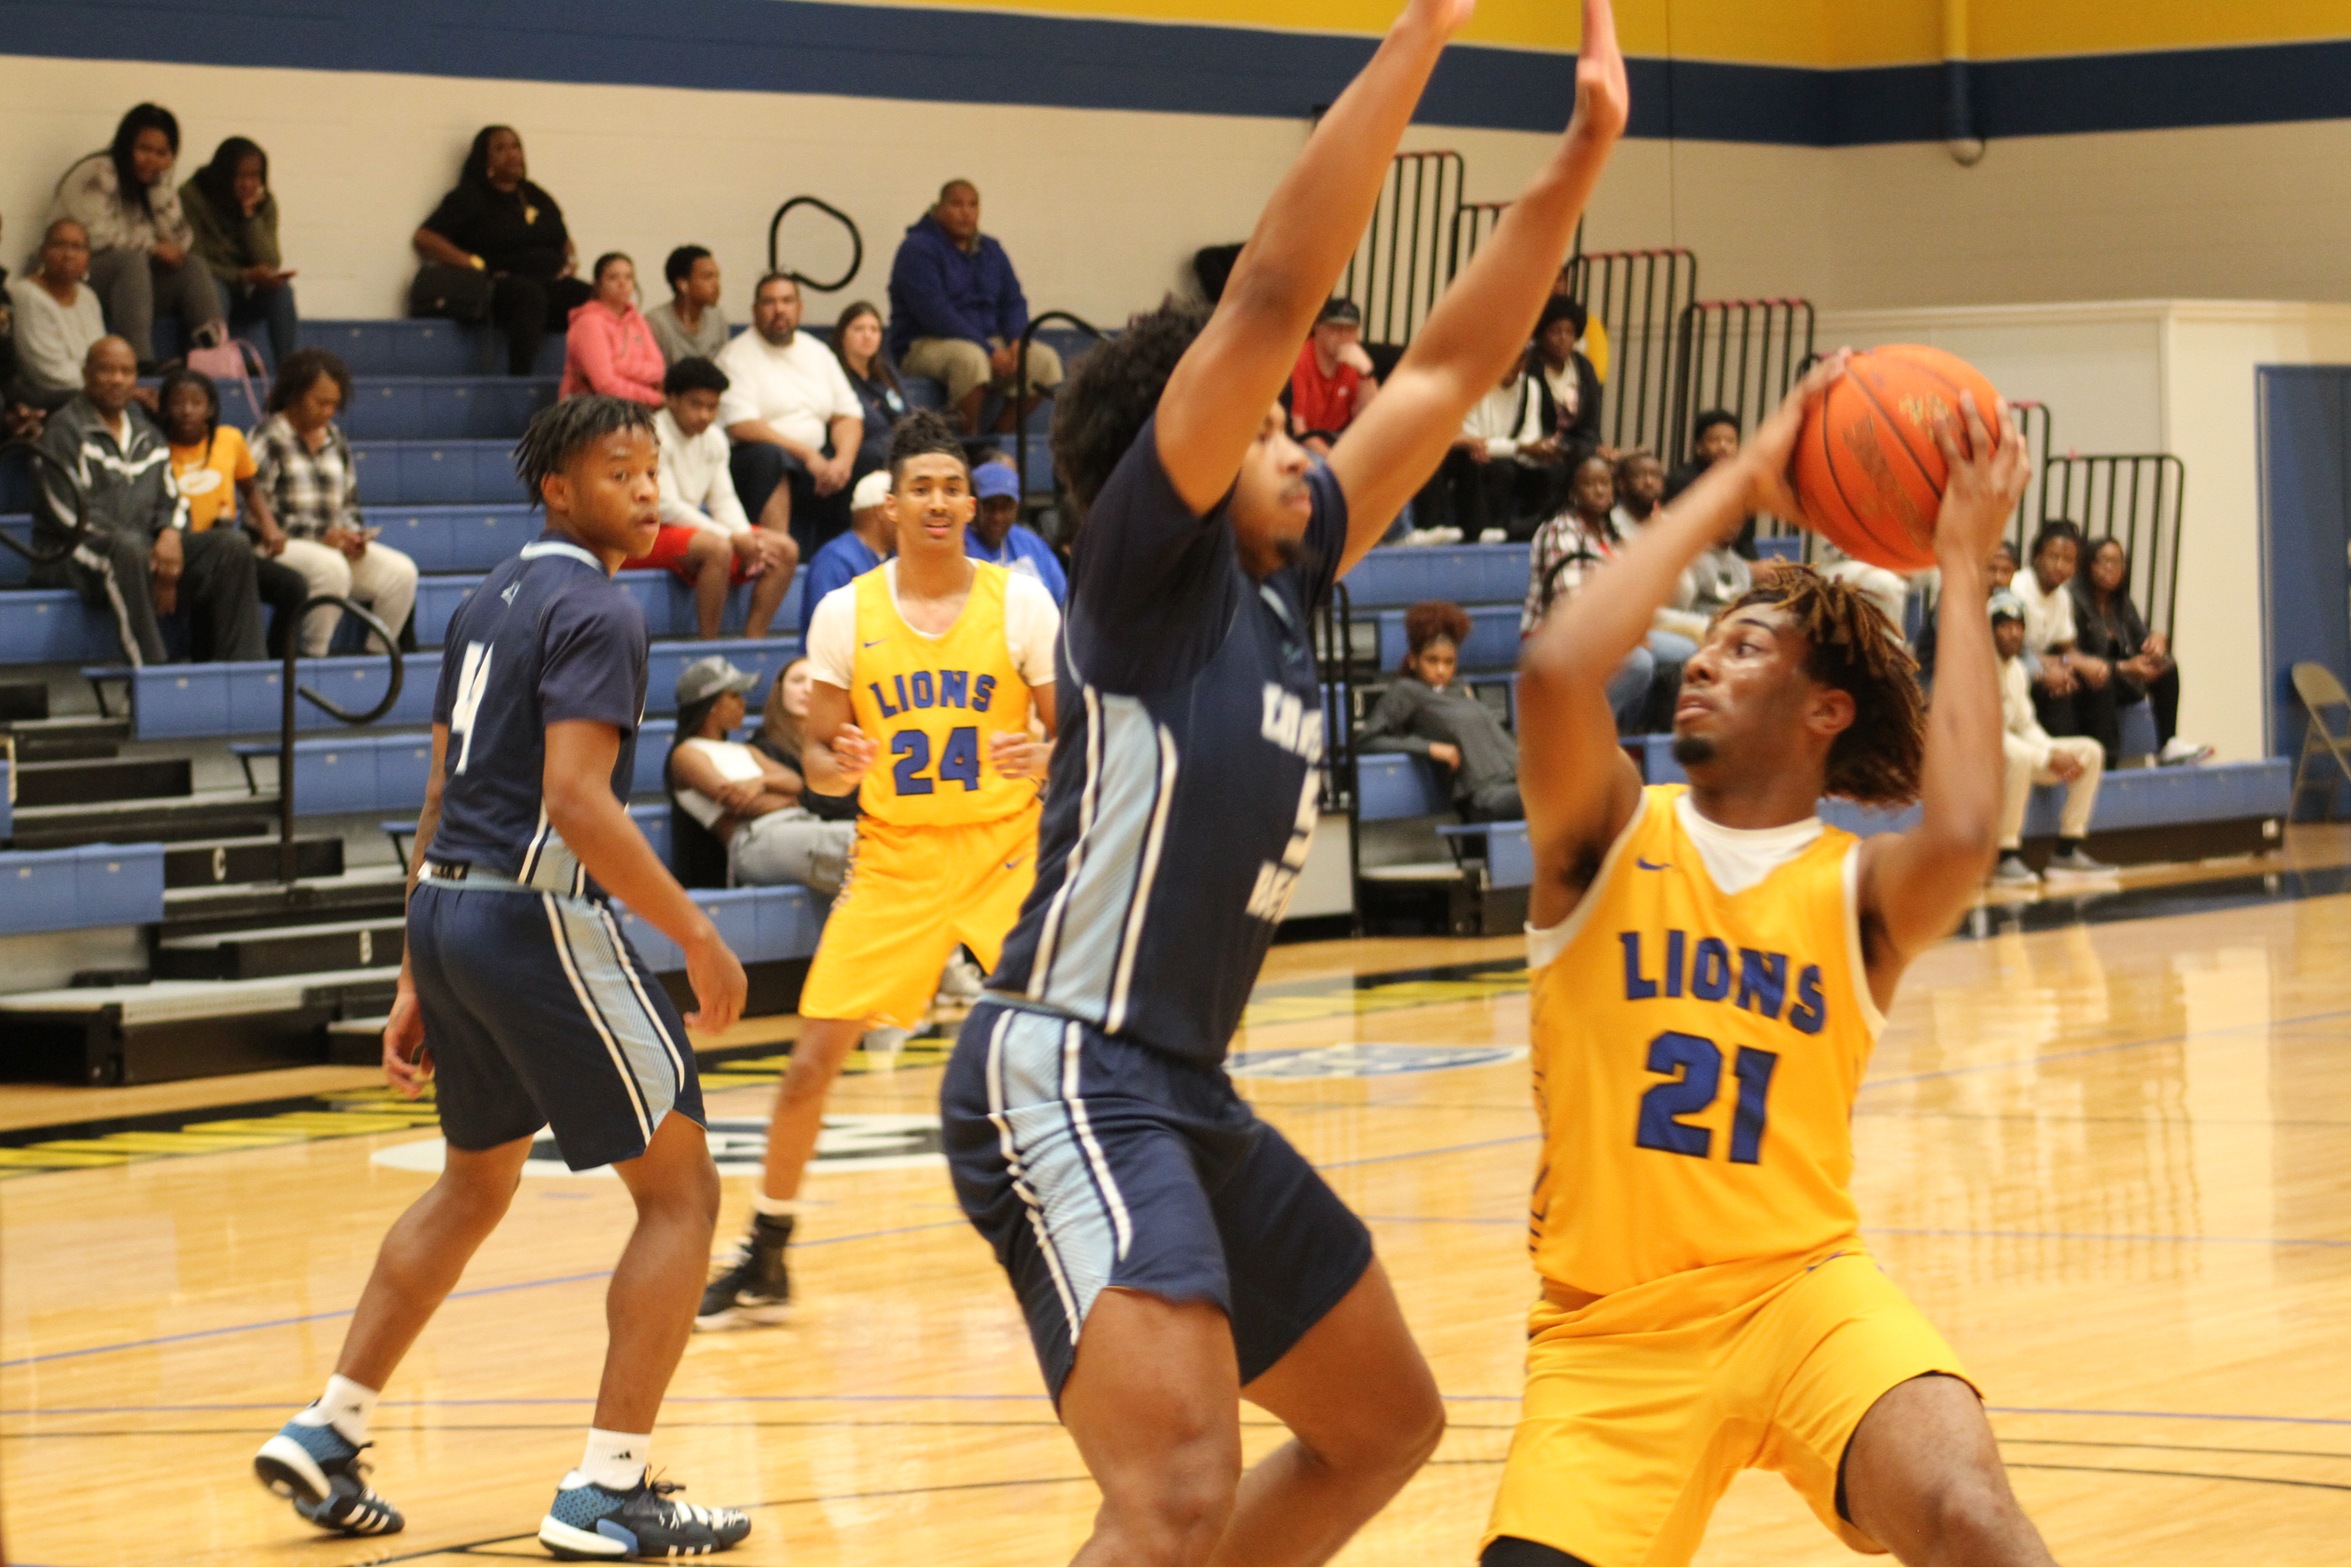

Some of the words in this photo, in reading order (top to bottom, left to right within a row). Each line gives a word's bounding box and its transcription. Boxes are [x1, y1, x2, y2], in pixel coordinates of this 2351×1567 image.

[451, 640, 495, 776] 4
[869, 669, 997, 719] LIONS
[891, 726, 981, 796] 24
[1617, 929, 1826, 1036] LIONS
[1635, 1029, 1780, 1166] 21
